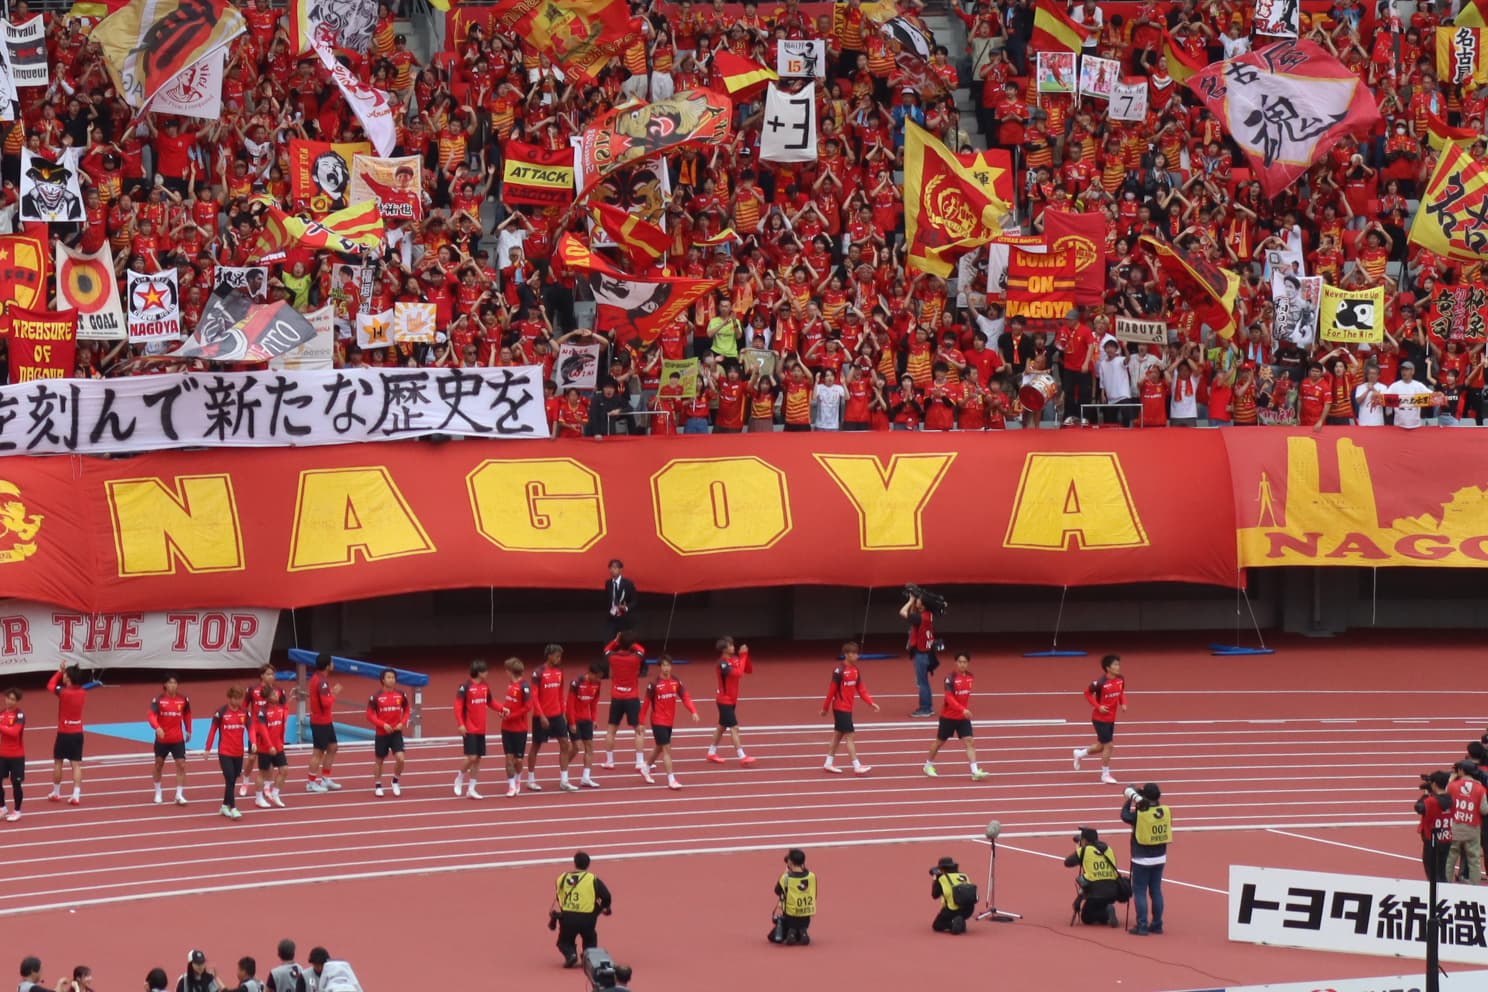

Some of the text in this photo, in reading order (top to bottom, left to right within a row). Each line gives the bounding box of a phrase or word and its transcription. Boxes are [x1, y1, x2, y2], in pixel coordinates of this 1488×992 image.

[788, 60, 801, 73] 15
[1119, 95, 1134, 117] 7
[1016, 251, 1068, 268] COME
[1027, 275, 1055, 294] ON
[12, 319, 73, 341] TREASURE
[89, 312, 119, 330] GOAL
[129, 319, 179, 337] NAGOYA
[1117, 321, 1162, 335] HARUYA
[33, 344, 52, 363] OF
[104, 451, 1152, 577] NAGOYA
[52, 610, 145, 653] THE
[167, 612, 260, 652] TOP
[1151, 825, 1168, 835] 002
[796, 895, 813, 907] 012
[1237, 883, 1488, 948] トヨタ紡織
